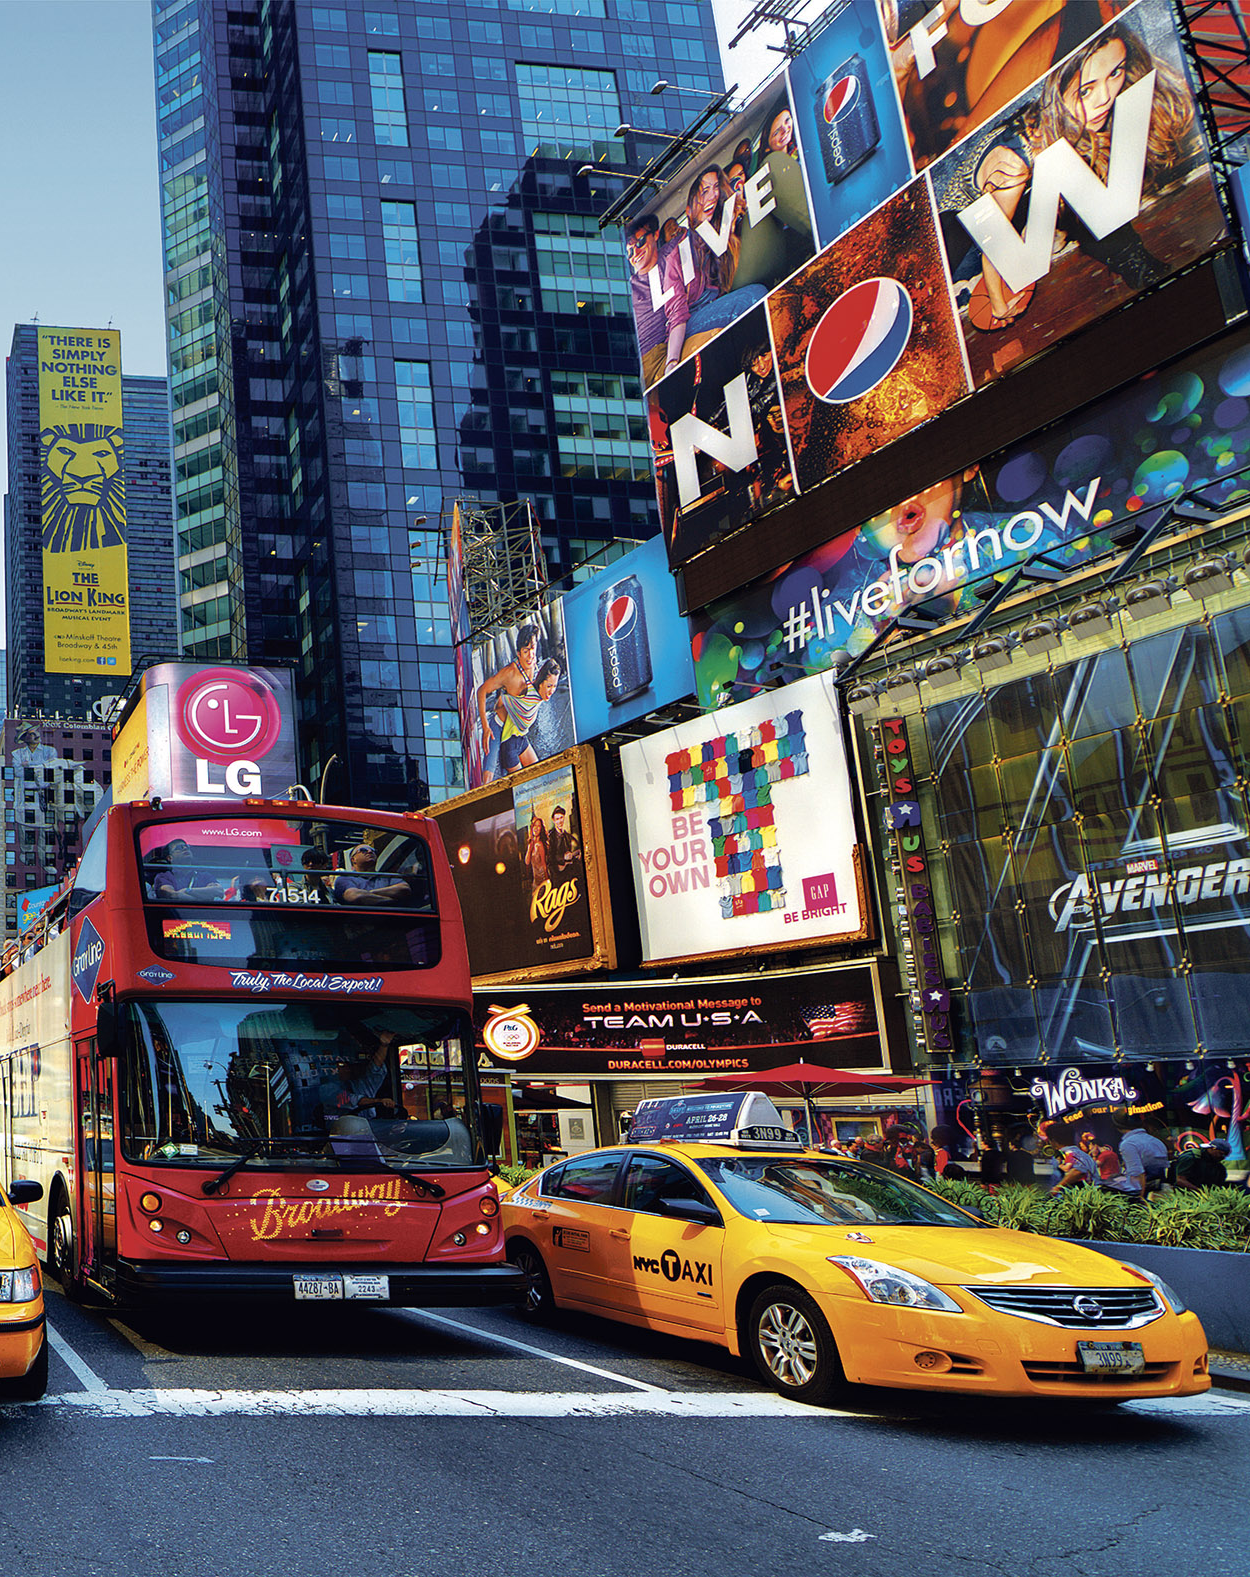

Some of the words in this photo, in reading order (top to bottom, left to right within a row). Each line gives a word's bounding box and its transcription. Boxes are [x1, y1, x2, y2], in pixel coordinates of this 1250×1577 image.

[828, 125, 846, 169] pepsi
[649, 162, 777, 313] LIVE
[98, 338, 111, 349] IS
[52, 349, 107, 362] SIMPLY
[41, 361, 118, 376] NOTHING
[62, 376, 98, 390] ELSE
[51, 389, 86, 402] LIKE
[783, 476, 1102, 654] #livefornow
[71, 572, 99, 584] THE
[46, 586, 83, 605] LION
[87, 587, 125, 607] KING
[57, 641, 92, 650] Broadway
[65, 633, 95, 641] Minskoff
[96, 634, 122, 642] Theatre
[607, 644, 623, 689] pepsi
[63, 722, 106, 730] Colombian
[884, 718, 913, 795] TOYS
[196, 758, 262, 796] LG
[202, 827, 263, 838] www.LG.com
[672, 811, 705, 841] BE
[638, 838, 708, 874] YOUR
[1126, 859, 1158, 874] MARVEL
[649, 864, 710, 898] OWN
[266, 887, 321, 904] 71514
[810, 883, 829, 900] GAP
[530, 877, 581, 932] Rags
[783, 911, 799, 924] BE
[801, 902, 847, 921] BRIGHT
[910, 883, 942, 985] BABIES
[230, 972, 270, 992] Truly,
[270, 973, 293, 986] The
[292, 973, 327, 990] Local
[327, 976, 382, 994] Expert!
[582, 1002, 611, 1014] Send
[614, 1005, 621, 1013] a
[624, 999, 696, 1013] Motivational
[698, 997, 749, 1012] Message
[750, 996, 762, 1007] to
[503, 1024, 519, 1032] P&G
[583, 1012, 674, 1029] TEAM
[665, 1042, 707, 1052] DURACELL
[608, 1058, 749, 1070] DURACELL.COM/OLYMPICS
[1030, 1067, 1138, 1117] WONKA
[686, 1115, 707, 1124] APRIL
[707, 1113, 728, 1122] 26-28
[753, 1127, 782, 1140] 3N99
[250, 1178, 408, 1241] Broadway
[633, 1255, 660, 1275] NYC
[661, 1249, 713, 1287] TAXI
[358, 1285, 376, 1293] 2243
